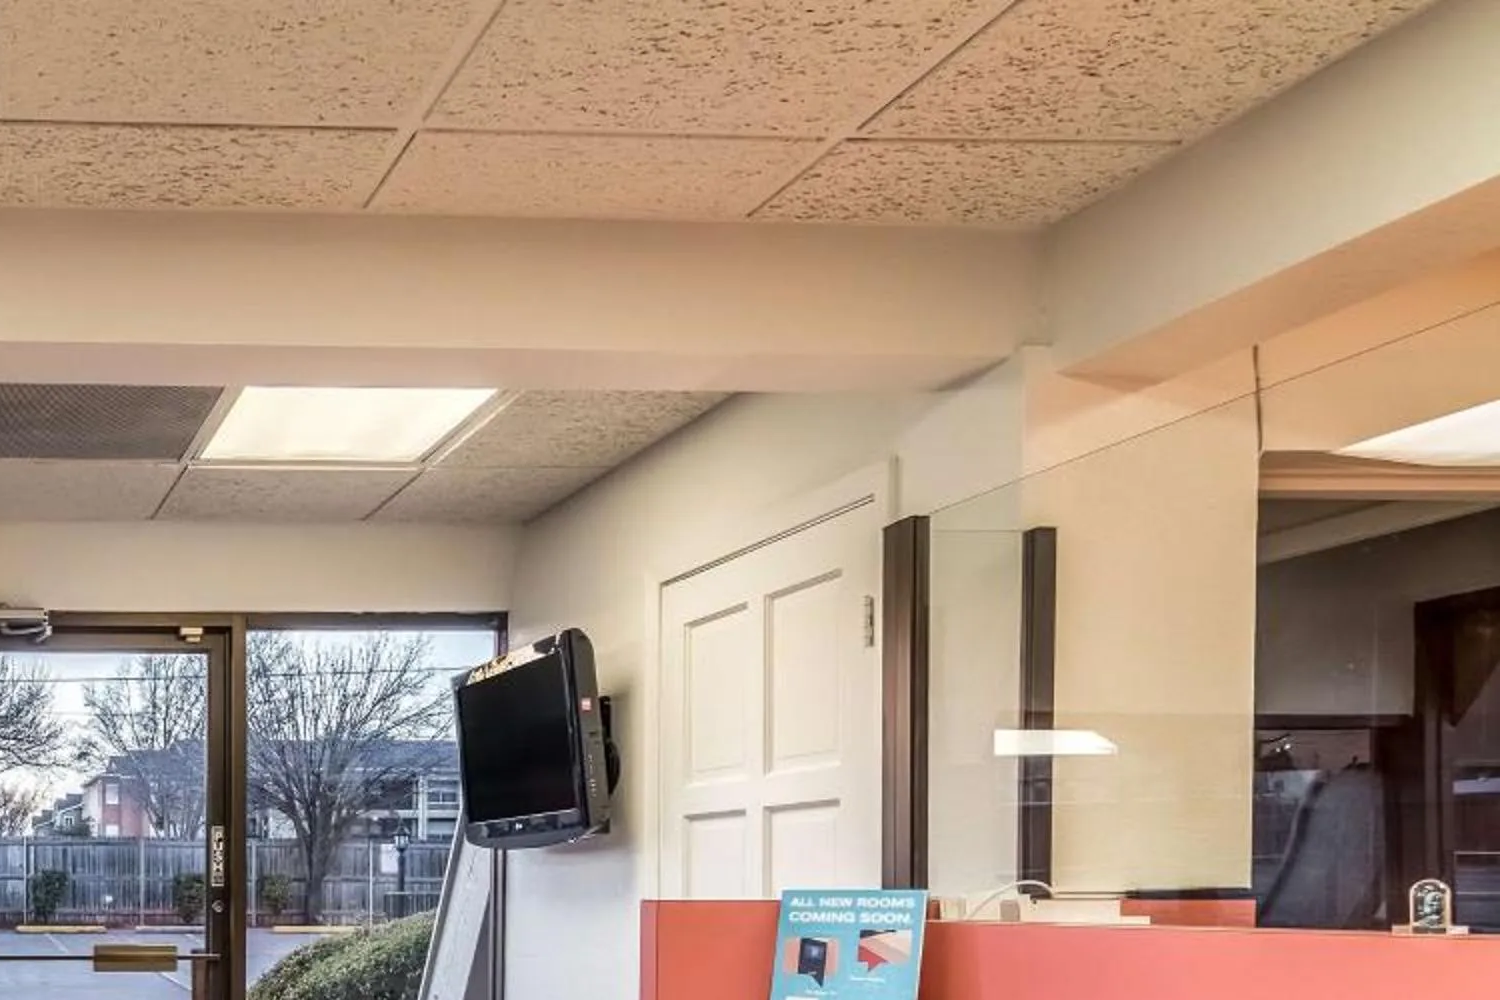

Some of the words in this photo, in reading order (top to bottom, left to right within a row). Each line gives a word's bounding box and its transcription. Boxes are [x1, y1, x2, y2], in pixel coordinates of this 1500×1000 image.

[212, 831, 224, 873] PUSH
[790, 896, 814, 908] ALL
[819, 896, 853, 909] NEW
[856, 896, 915, 910] ROOMS
[788, 910, 855, 923] COMING
